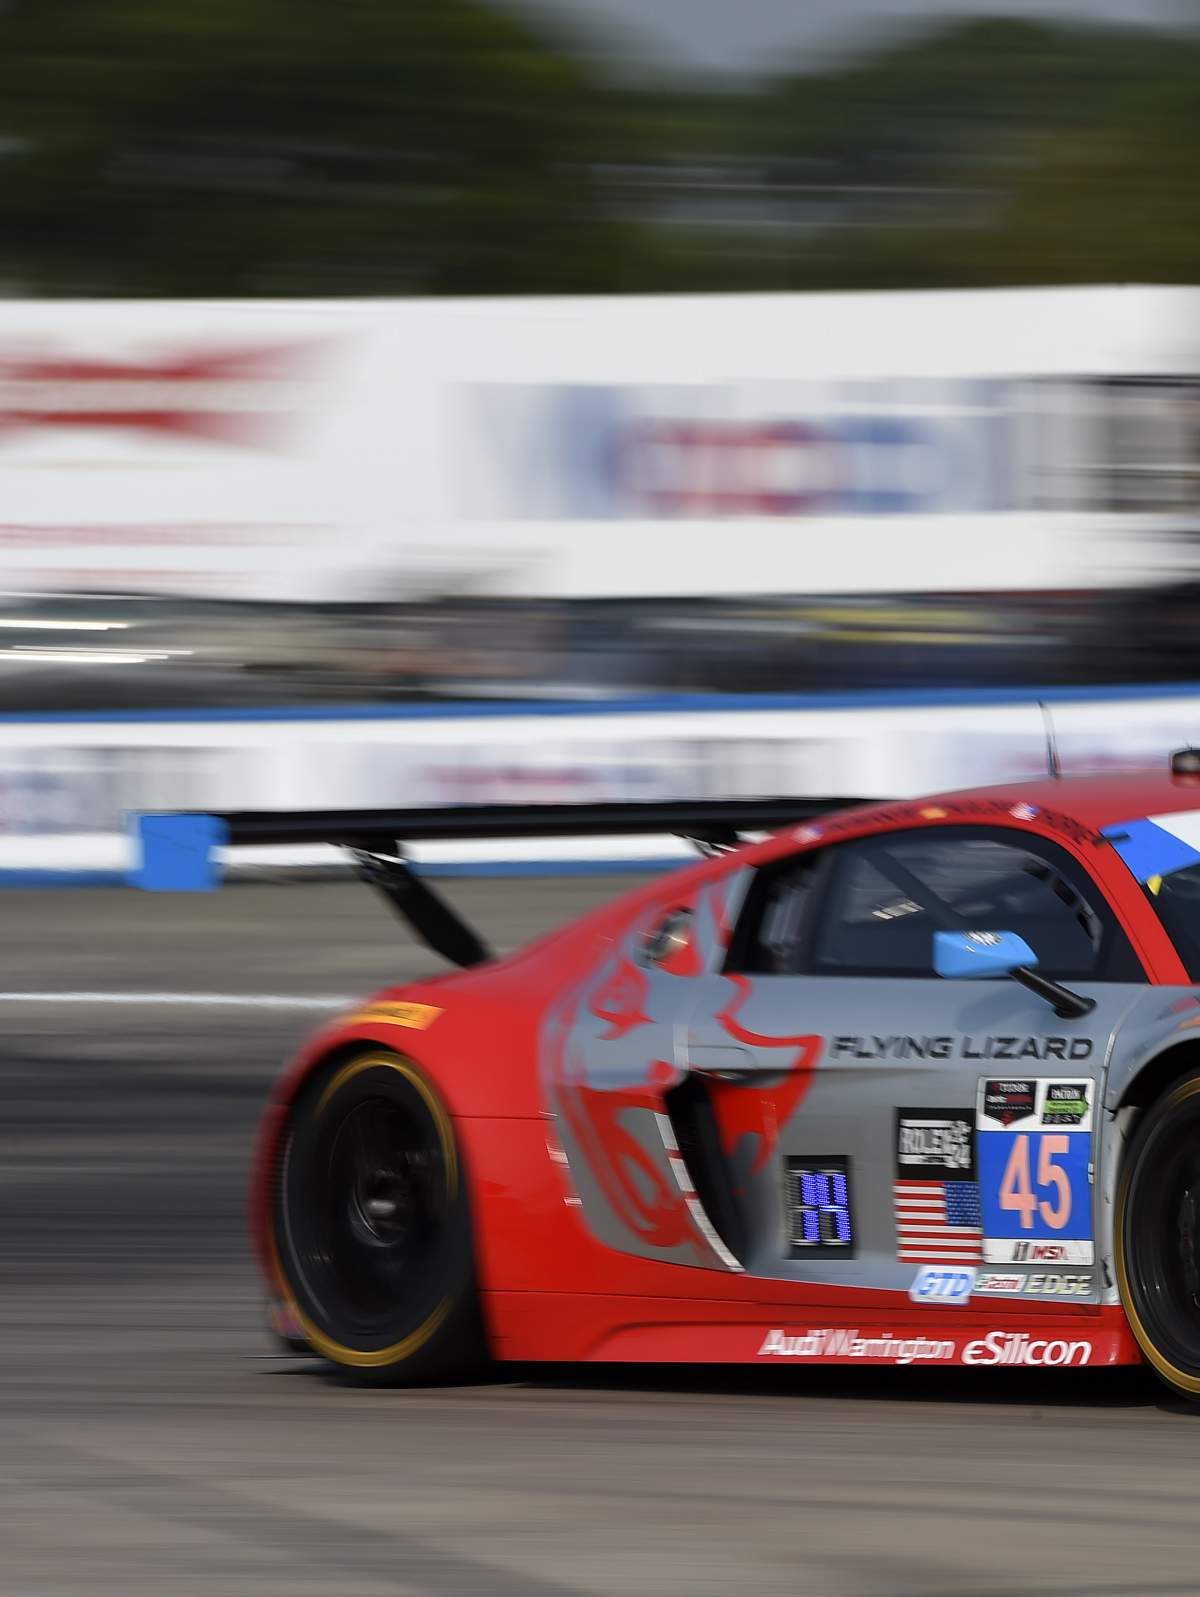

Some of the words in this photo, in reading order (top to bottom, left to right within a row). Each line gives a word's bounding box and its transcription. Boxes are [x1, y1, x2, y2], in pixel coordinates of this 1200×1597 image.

[830, 1036, 954, 1059] FLYING
[960, 1036, 1093, 1060] LIZARD
[999, 1135, 1073, 1230] 45
[1024, 1274, 1093, 1296] EDGE
[757, 1329, 824, 1356] Audi
[961, 1331, 1093, 1366] eSilicon
